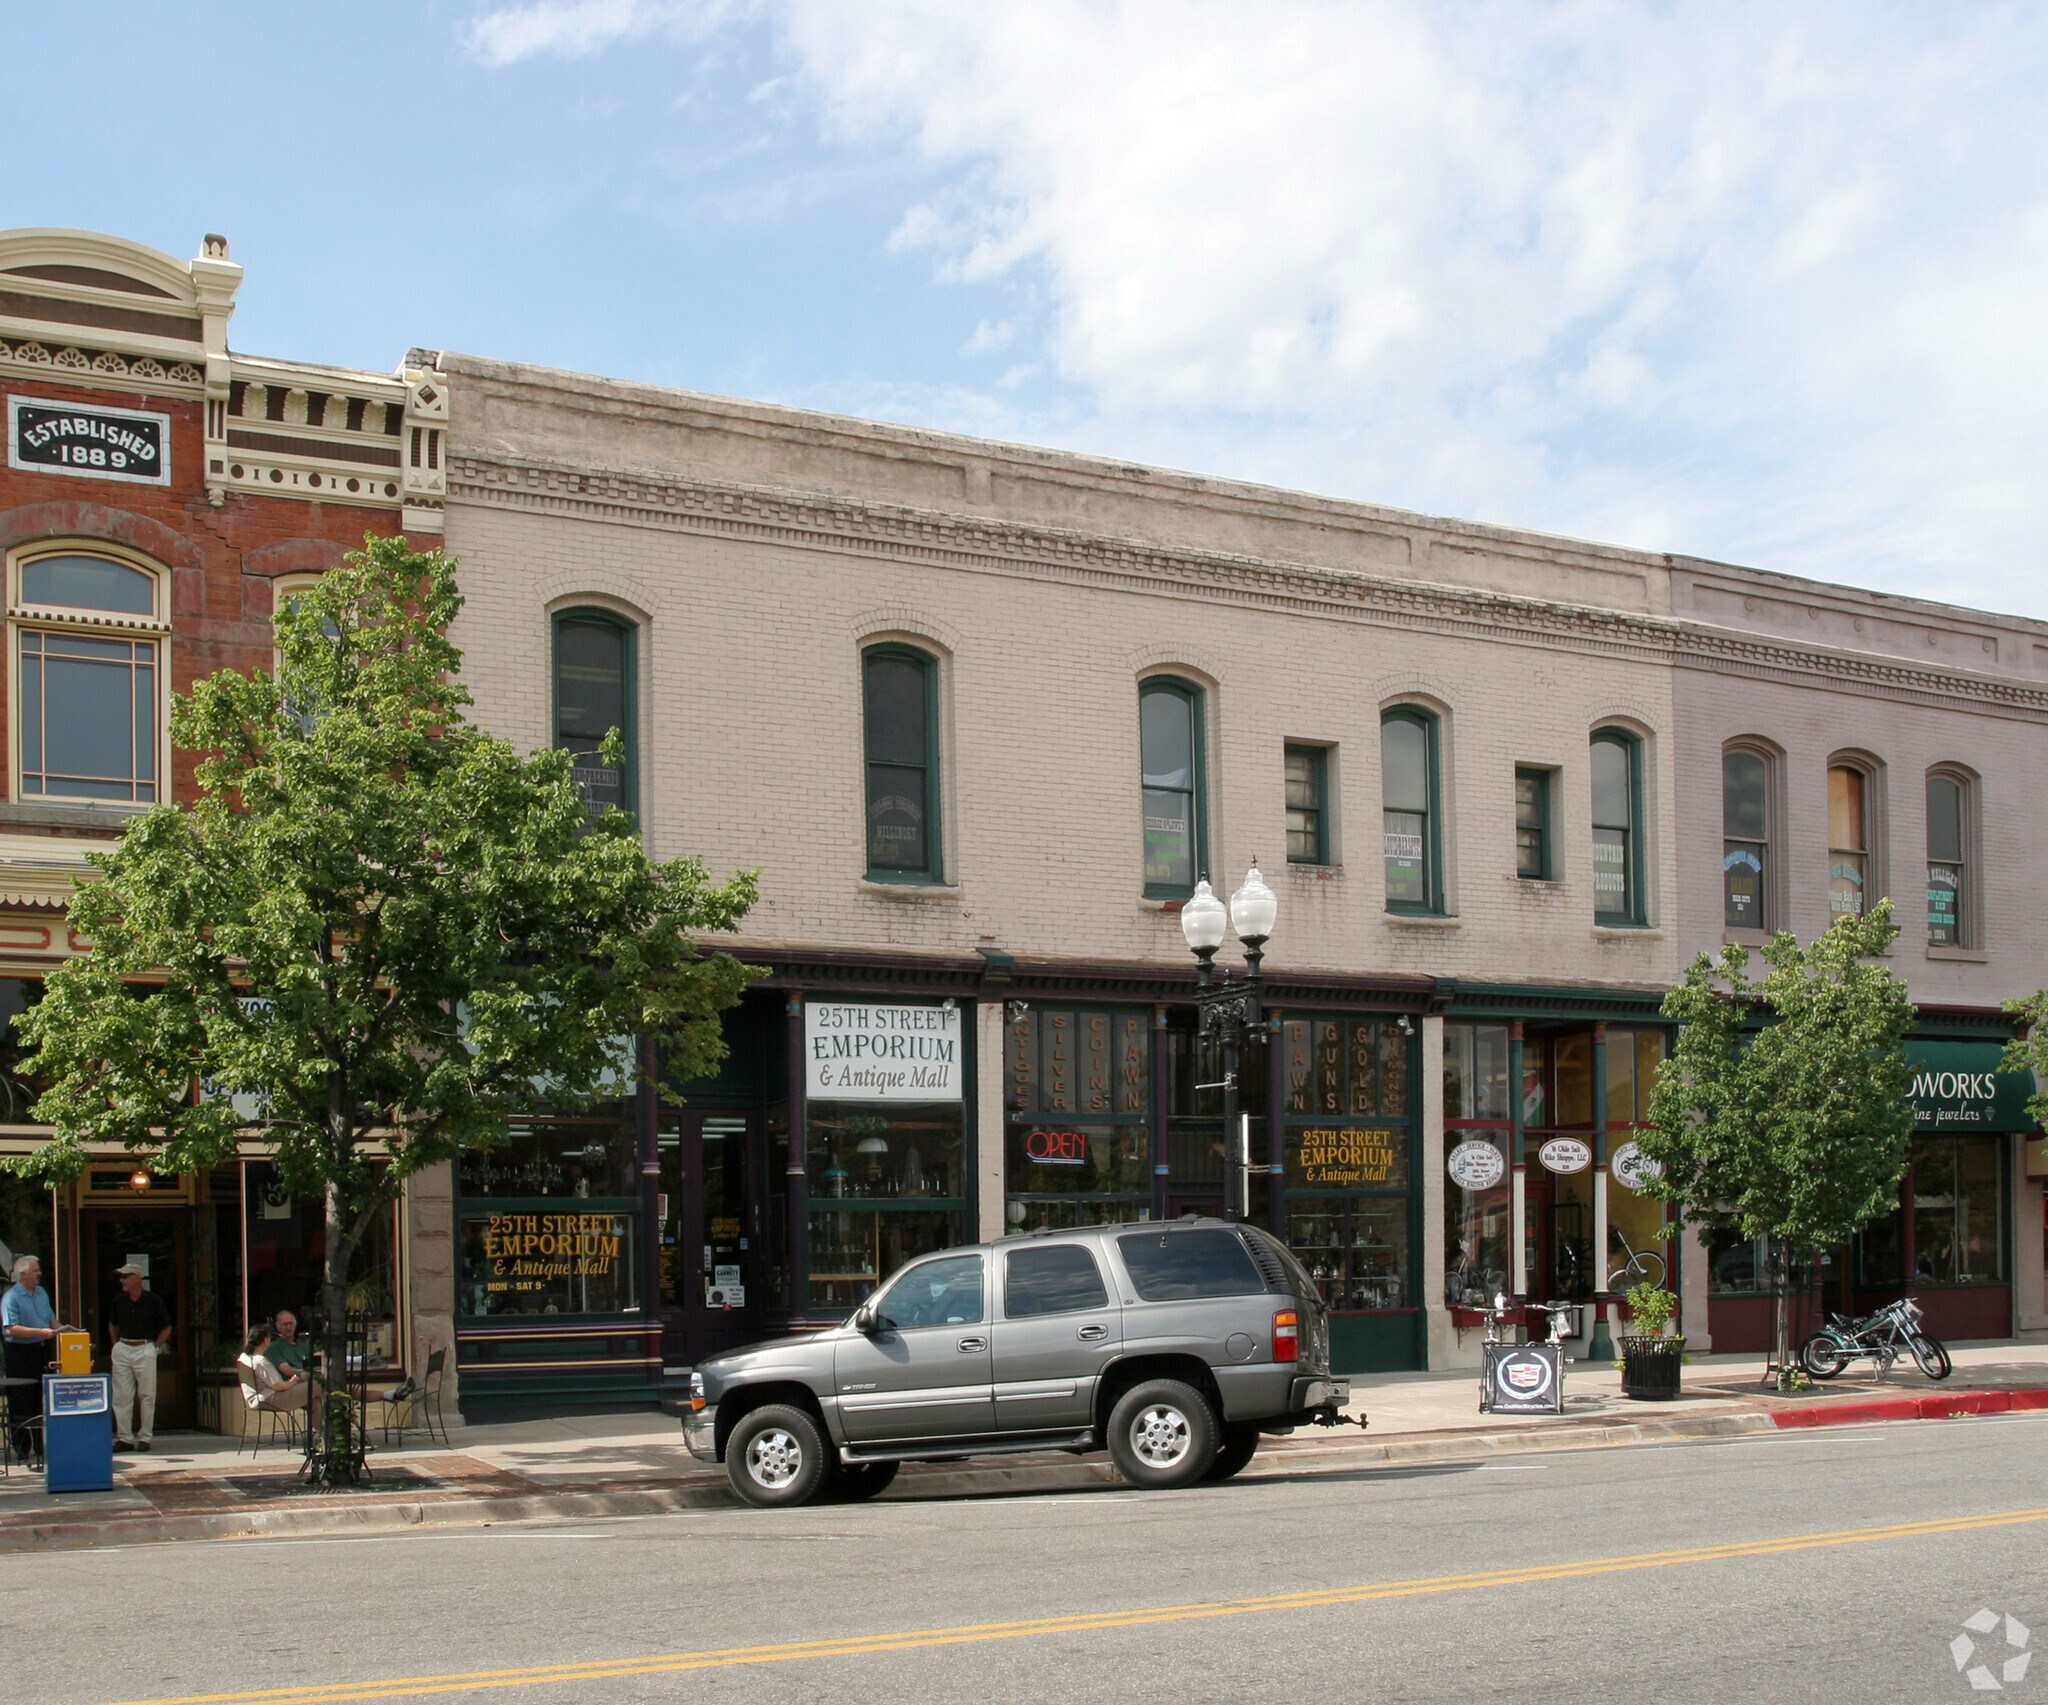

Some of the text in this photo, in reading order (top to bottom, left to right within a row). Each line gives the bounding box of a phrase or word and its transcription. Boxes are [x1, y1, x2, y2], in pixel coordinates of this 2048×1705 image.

[24, 418, 156, 461] ESTABLISHED
[61, 445, 127, 468] 1889
[819, 1006, 951, 1030] 25TH STREET
[813, 1034, 955, 1062] EMPORIUM
[1052, 1016, 1068, 1109] SILVER
[1089, 1018, 1105, 1110] COINS
[1124, 1019, 1140, 1110] PAWN
[1290, 1025, 1306, 1110] PAWN
[1325, 1024, 1337, 1110] GUNS
[1356, 1027, 1369, 1111] GOLD
[1387, 1026, 1400, 1113] DIAMONDS
[819, 1064, 949, 1094] & Antique Mall
[1936, 1101, 1980, 1127] jewelers
[1027, 1131, 1087, 1159] OPEN
[1303, 1130, 1390, 1147] 25TH STREET
[1300, 1147, 1394, 1167] EMPORIUM
[1306, 1166, 1387, 1185] & Antique Mall
[490, 1214, 615, 1234] 25TH STREET
[484, 1234, 620, 1258] EMPORIUM
[494, 1257, 609, 1281] & Antique Mall
[488, 1282, 507, 1291] MON
[516, 1282, 533, 1290] SAT
